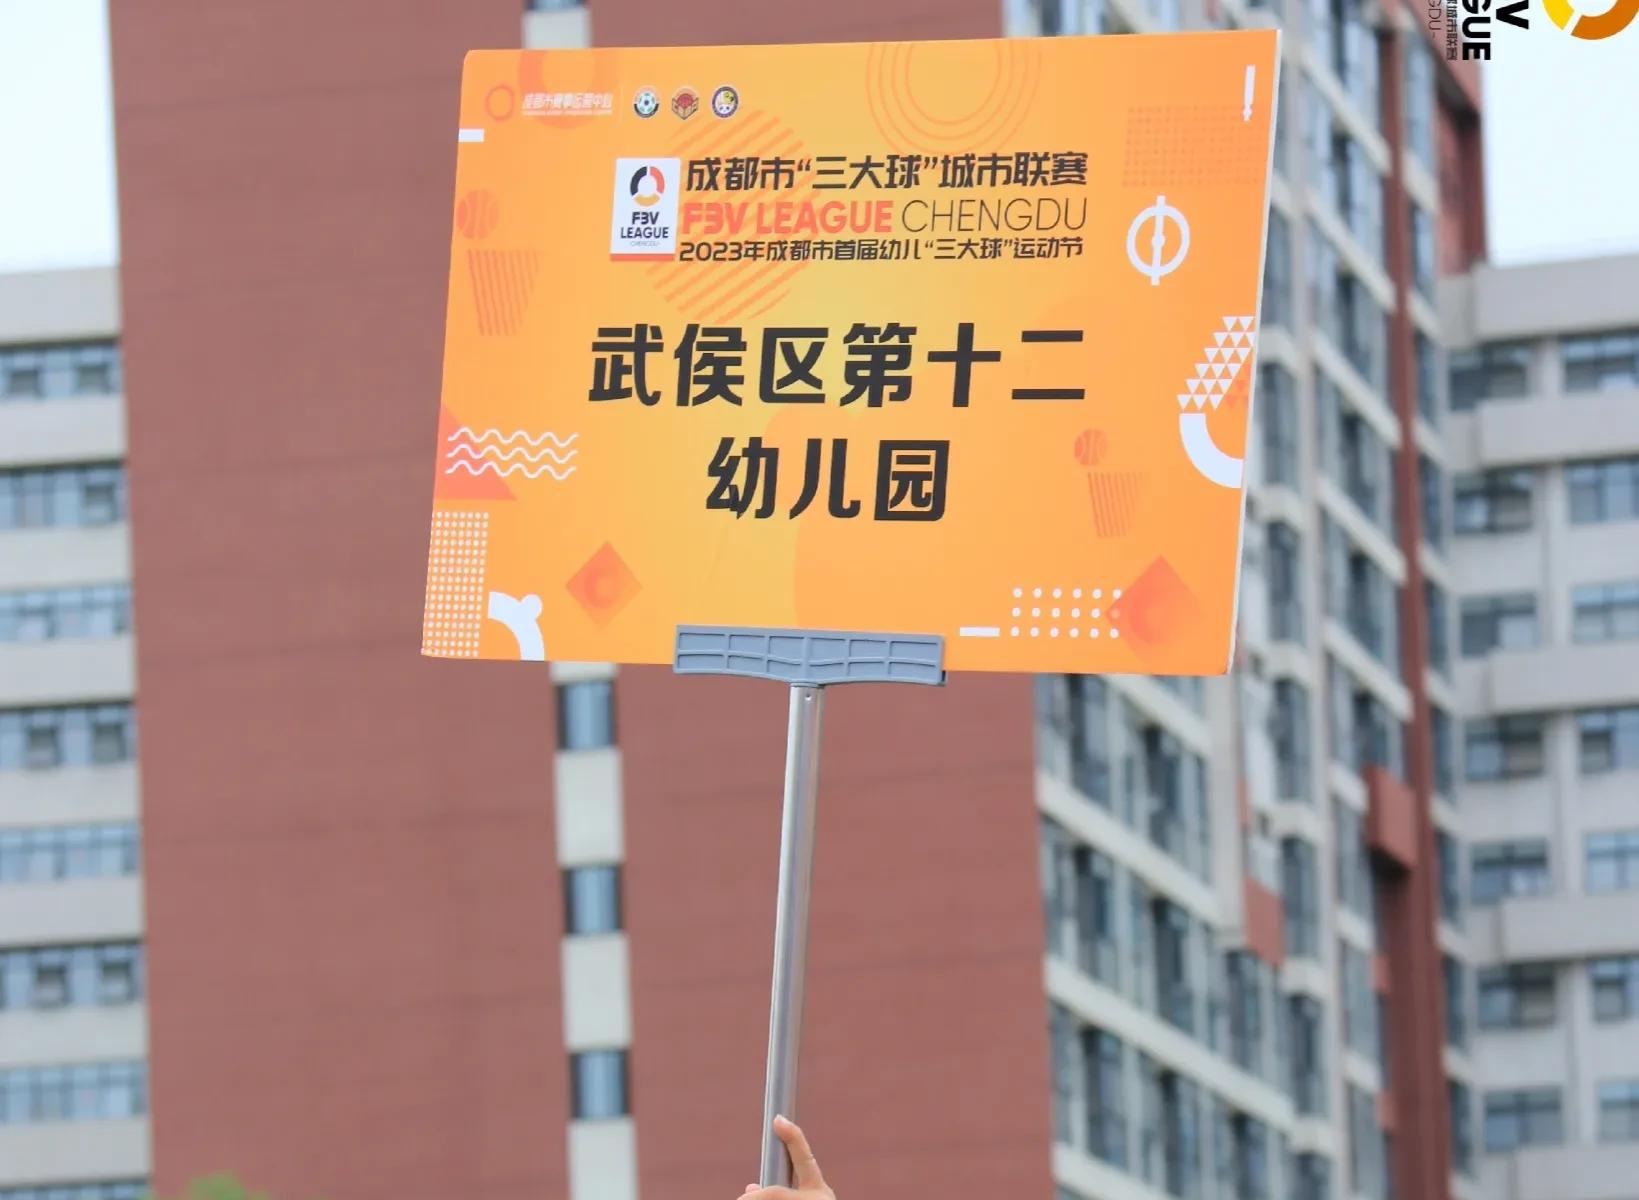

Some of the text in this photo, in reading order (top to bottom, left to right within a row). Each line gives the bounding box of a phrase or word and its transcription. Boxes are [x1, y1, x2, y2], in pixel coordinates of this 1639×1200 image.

[620, 227, 669, 239] LEAGUE
[756, 200, 893, 235] LEAGUE
[902, 197, 1088, 233] CHENGDU
[588, 322, 1086, 409] 武侯区第十二
[705, 436, 950, 523] 幼儿园
